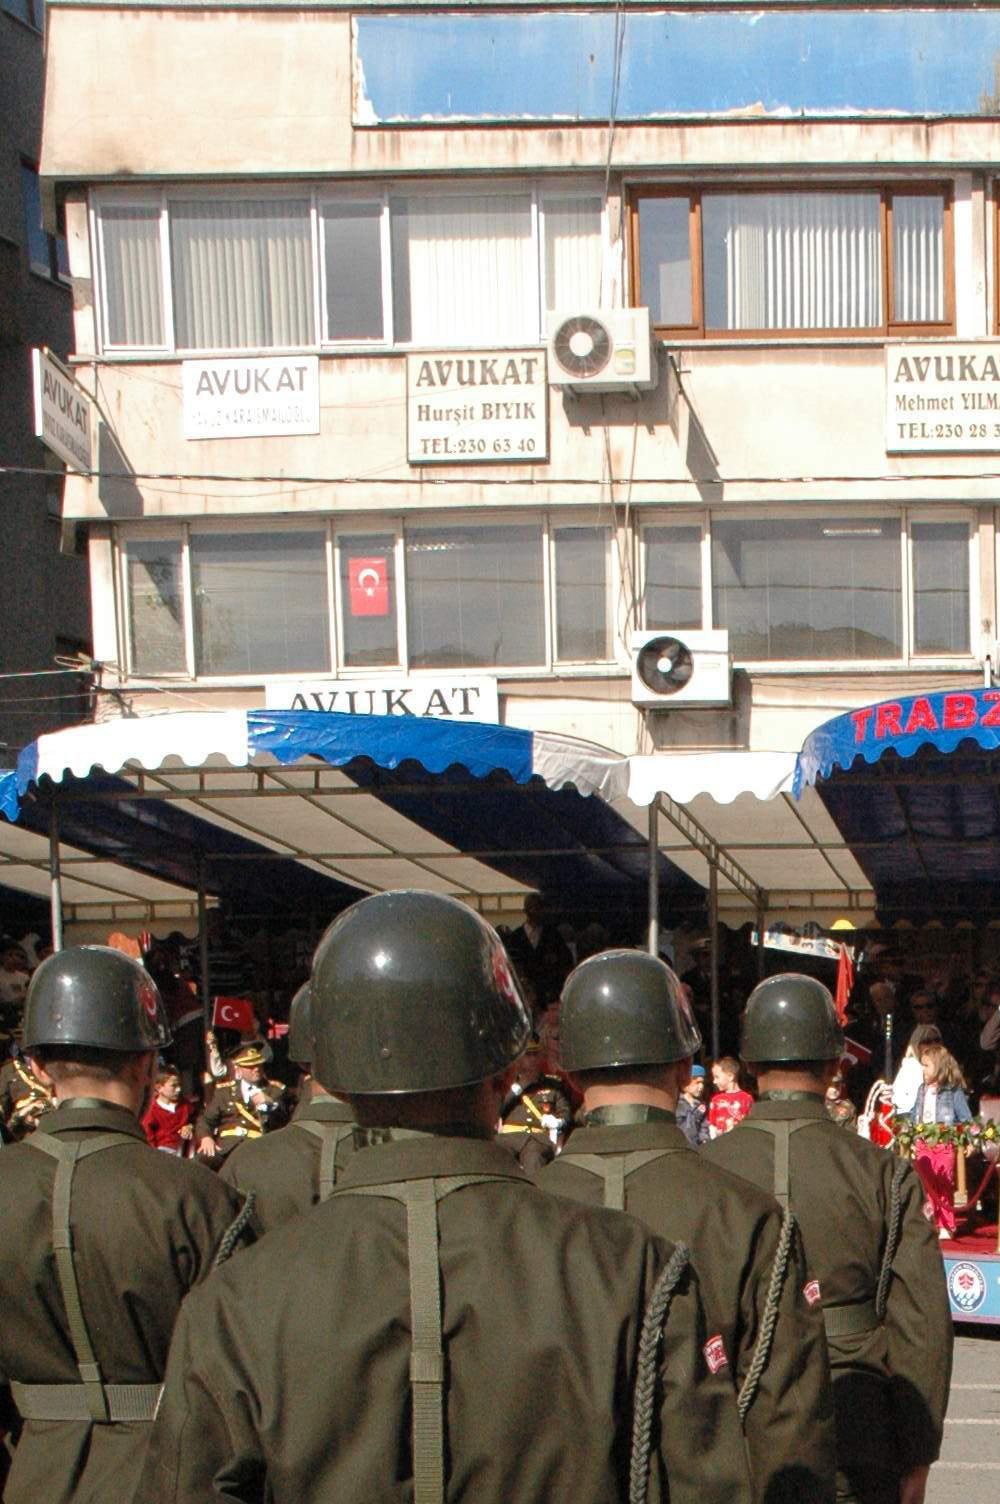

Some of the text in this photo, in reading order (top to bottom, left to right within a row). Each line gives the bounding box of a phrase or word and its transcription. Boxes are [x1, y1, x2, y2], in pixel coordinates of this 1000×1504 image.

[195, 366, 308, 396] AVUKAT
[415, 357, 539, 388] AVUKAT
[43, 368, 87, 435] AVUKAT
[417, 402, 536, 427] Hurşit BIYIK
[895, 394, 955, 412] Mehmet
[897, 422, 964, 439] TEL:230
[968, 423, 988, 438] 28
[420, 437, 537, 455] TEL:230 63 40
[290, 686, 481, 716] AVUKAT
